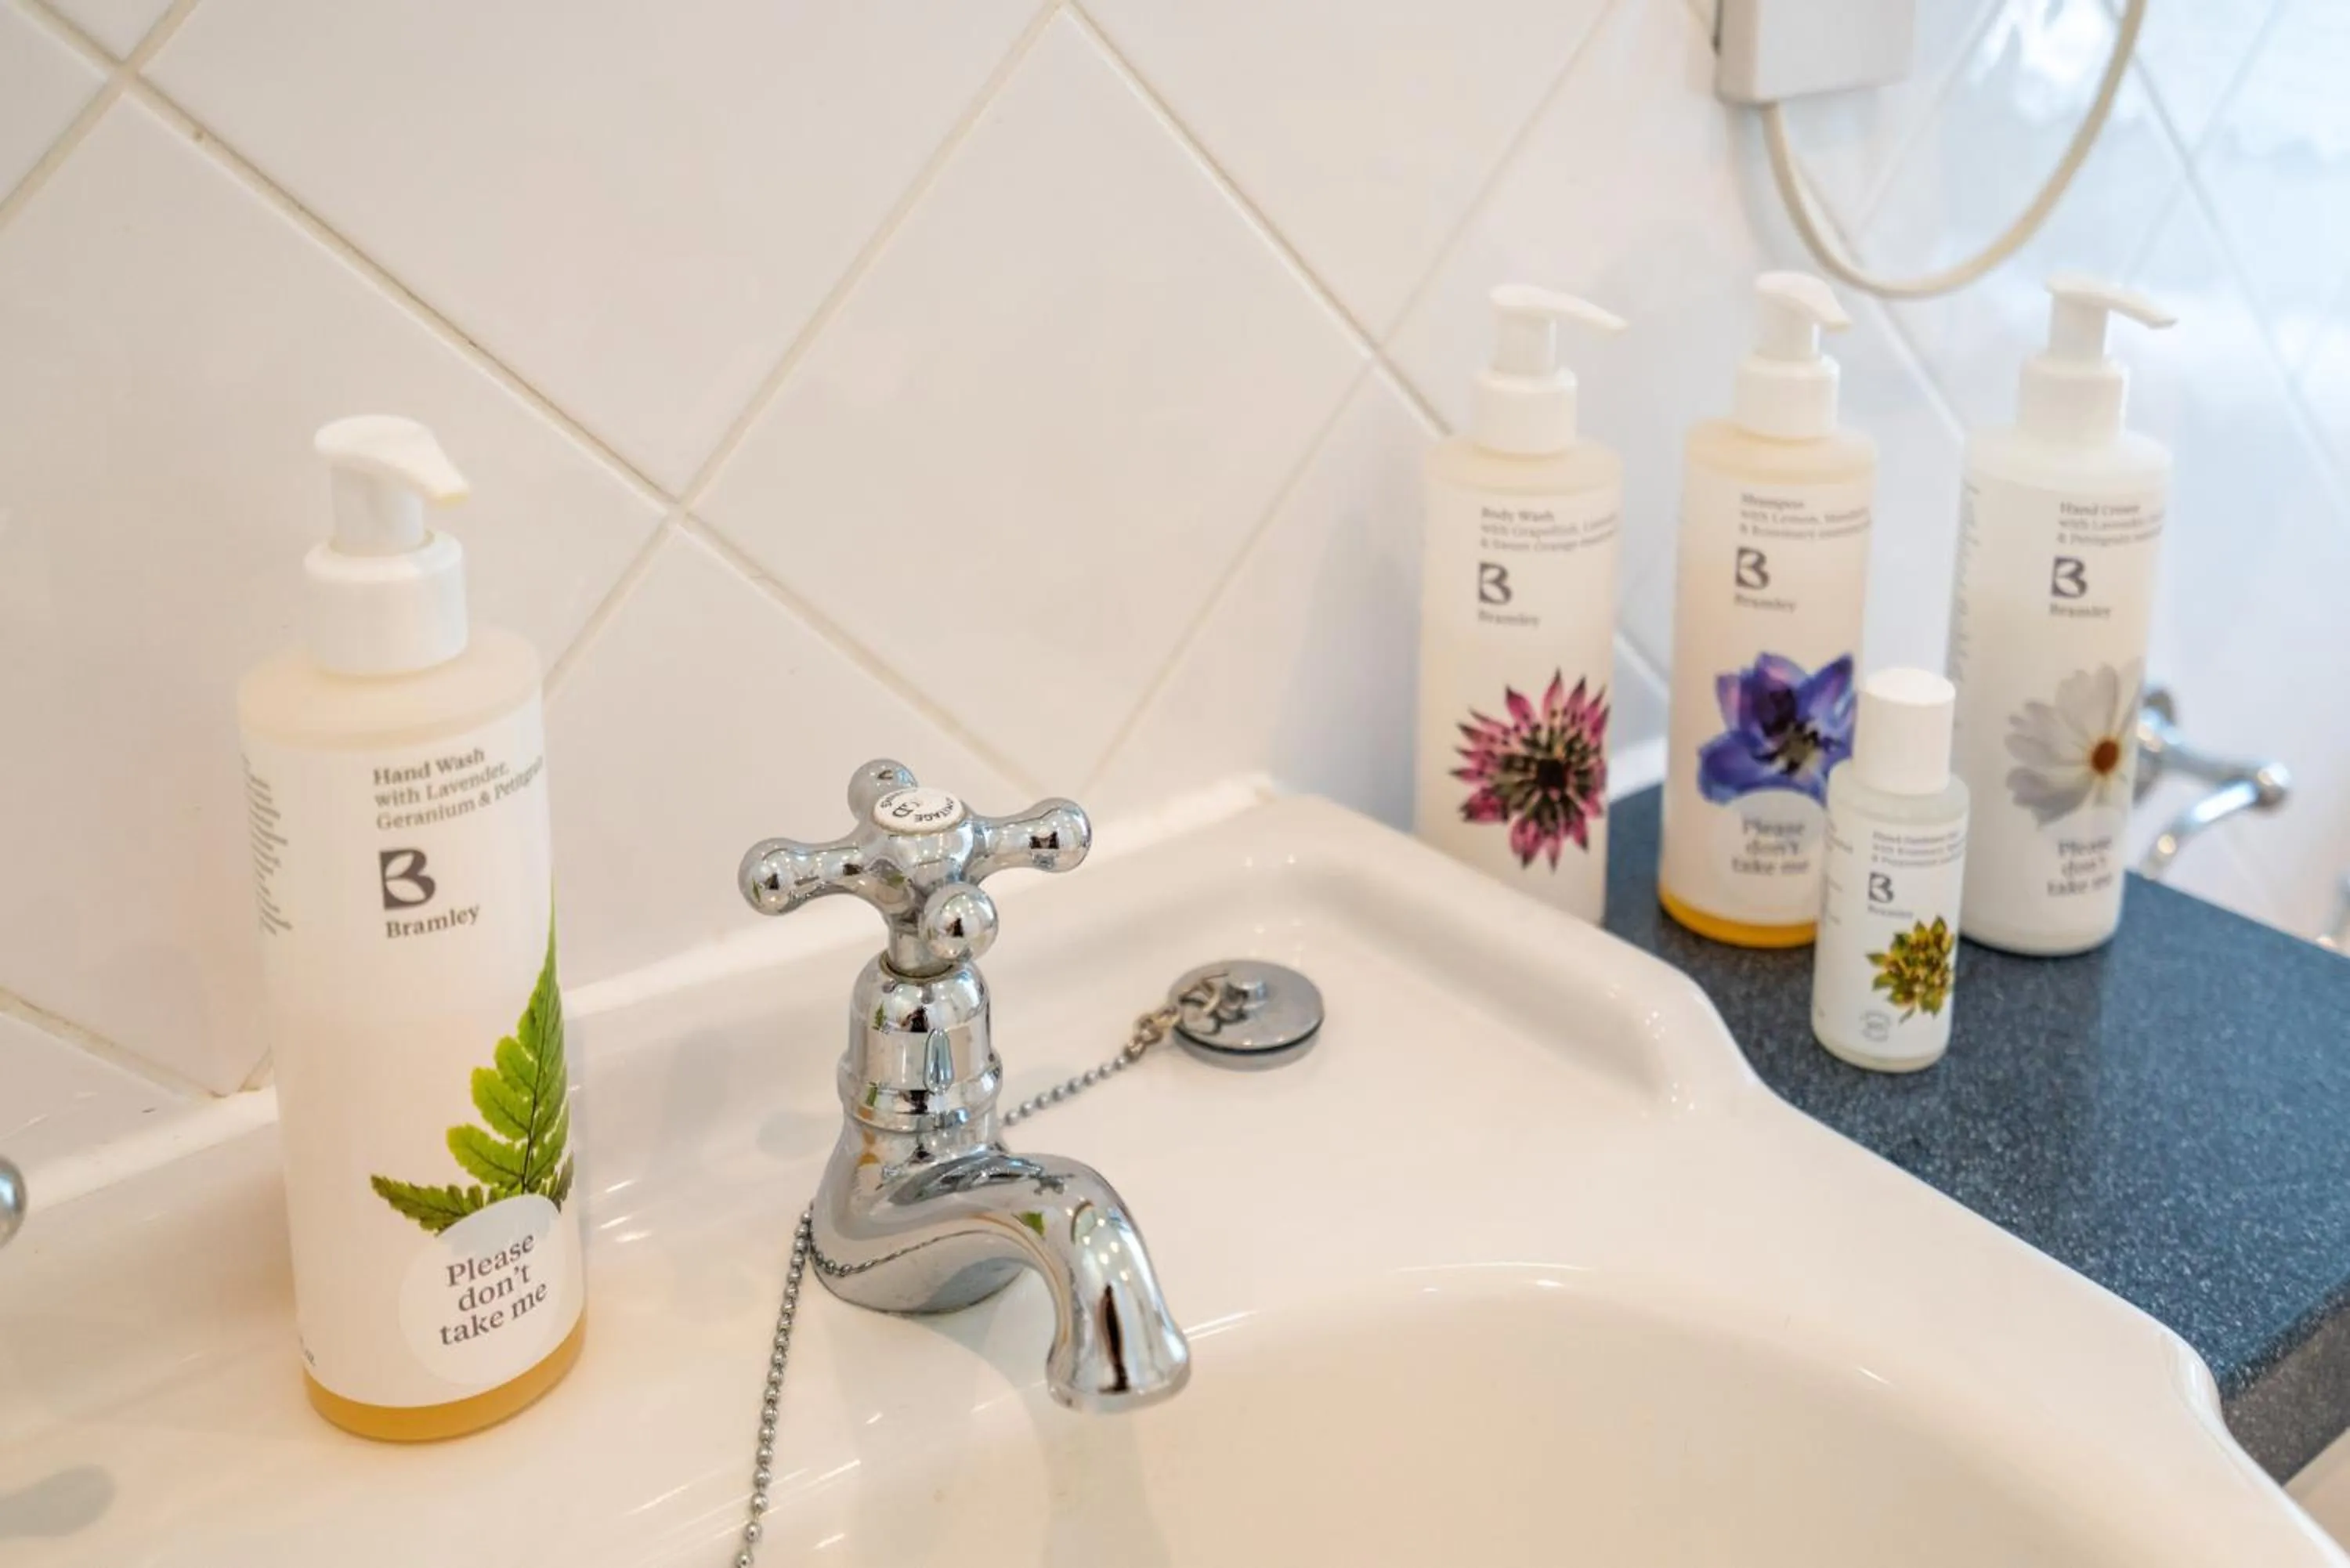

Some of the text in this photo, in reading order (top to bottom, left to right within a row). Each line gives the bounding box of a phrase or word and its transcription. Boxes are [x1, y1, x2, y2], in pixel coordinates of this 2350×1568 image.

[1481, 508, 1514, 522] Body
[2060, 501, 2099, 515] Hand
[1734, 593, 1795, 613] Bramley
[2049, 603, 2111, 619] Bramley
[1478, 609, 1540, 629] Bramley
[373, 747, 485, 786] Hand Wash
[374, 762, 510, 807] with Lavender,
[377, 800, 475, 830] Geranium
[478, 790, 492, 808] &
[1742, 818, 1805, 836] Please
[2059, 837, 2112, 857] Please
[1731, 855, 1775, 876] take
[2047, 879, 2088, 896] take
[386, 904, 480, 938] Bramley
[446, 1234, 534, 1287] Please
[458, 1264, 530, 1312] don't
[439, 1283, 547, 1345] take me
